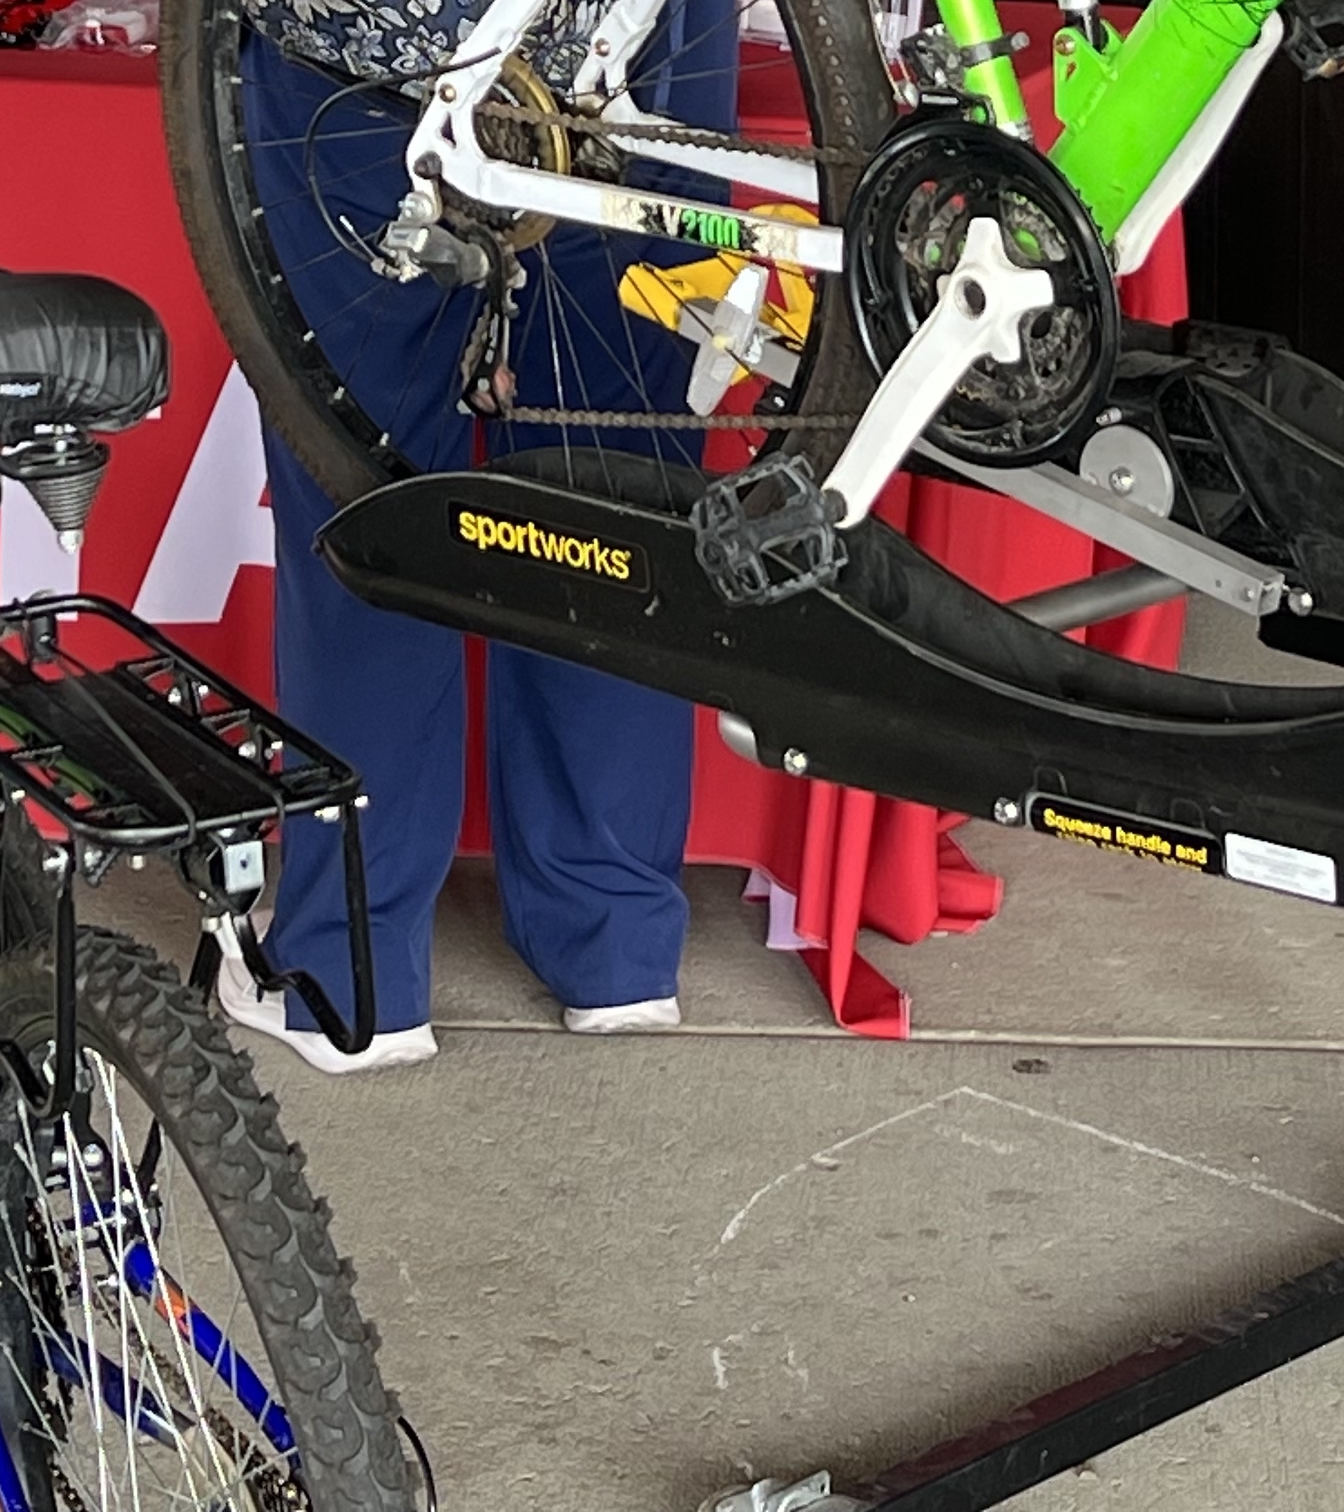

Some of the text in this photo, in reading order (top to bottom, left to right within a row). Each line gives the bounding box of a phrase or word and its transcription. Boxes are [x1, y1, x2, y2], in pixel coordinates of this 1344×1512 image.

[459, 511, 630, 579] sportworks
[1043, 808, 1112, 841] Squeeze
[1116, 826, 1172, 855] handle
